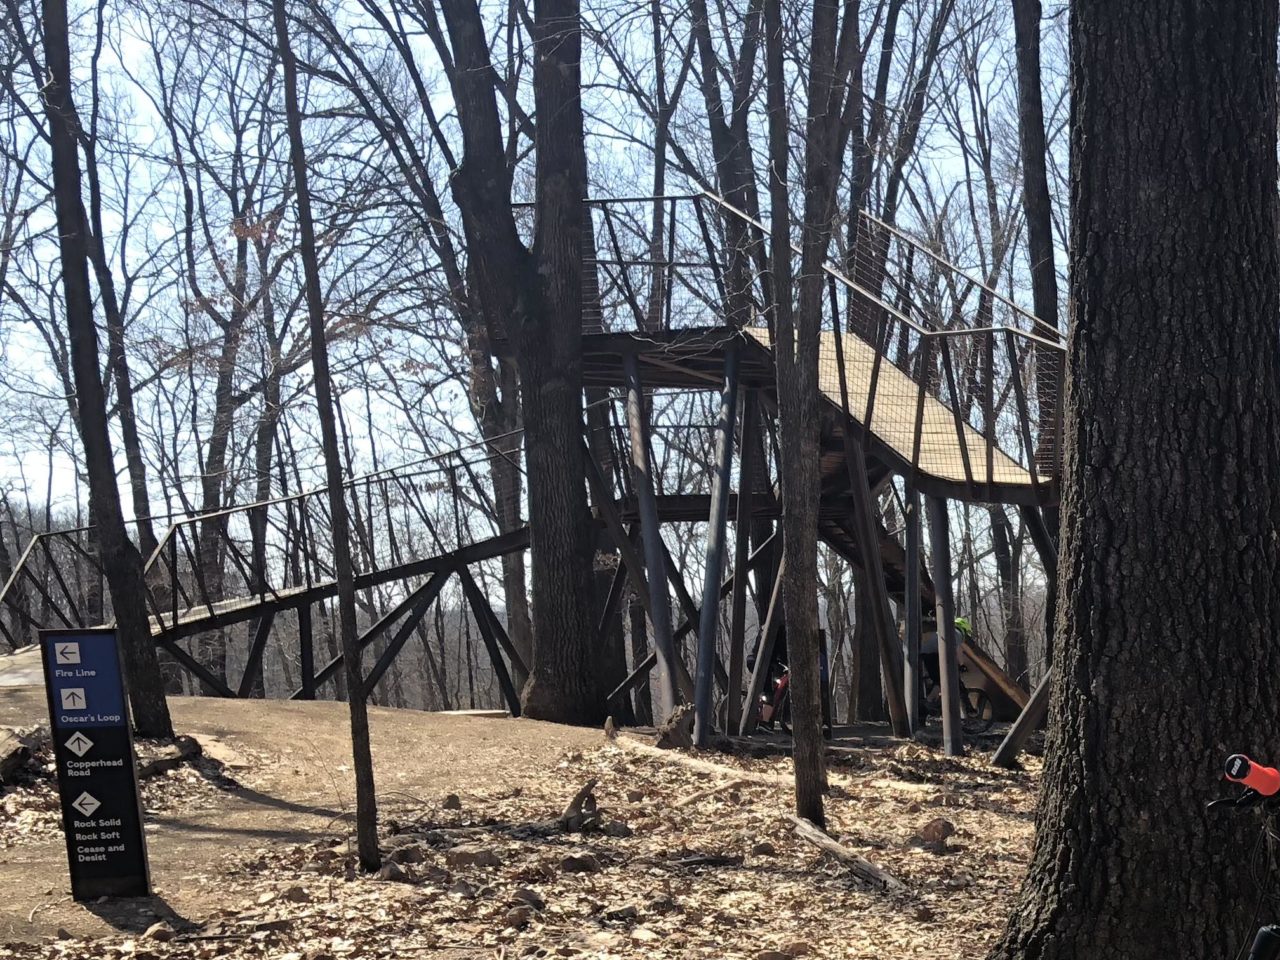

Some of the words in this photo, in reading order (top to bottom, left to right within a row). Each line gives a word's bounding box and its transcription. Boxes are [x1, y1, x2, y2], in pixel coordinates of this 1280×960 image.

[61, 714, 94, 722] Oscar's
[98, 714, 120, 722] Loop
[67, 759, 123, 768] Copperhead
[74, 820, 96, 828] Rock
[78, 854, 106, 862] Desist
